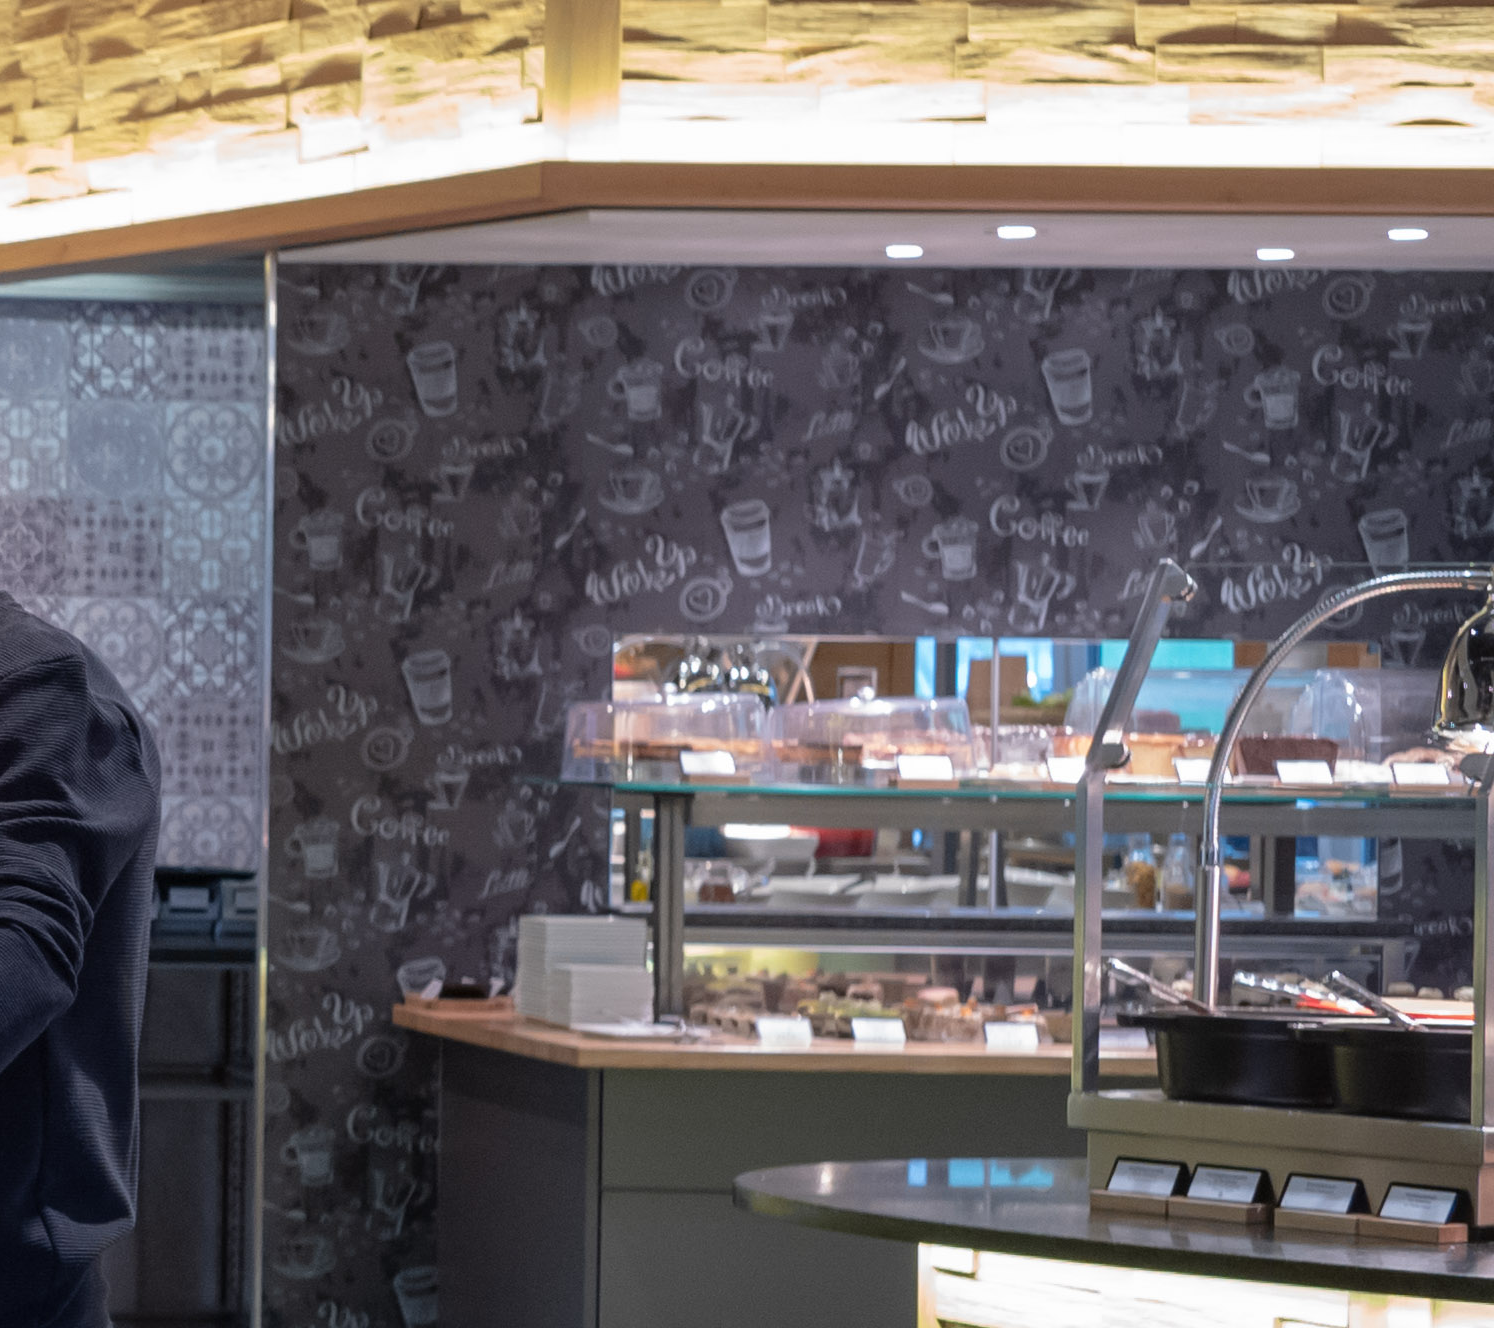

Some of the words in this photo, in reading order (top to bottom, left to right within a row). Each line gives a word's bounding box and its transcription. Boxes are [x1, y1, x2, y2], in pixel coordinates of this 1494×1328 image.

[674, 336, 773, 388] Coffee
[1312, 344, 1413, 396] Coffee
[965, 383, 1017, 427] Up
[356, 486, 455, 538] Coffee
[989, 495, 1089, 547] Coffee
[645, 534, 696, 578] Up
[351, 795, 450, 846] Coffee
